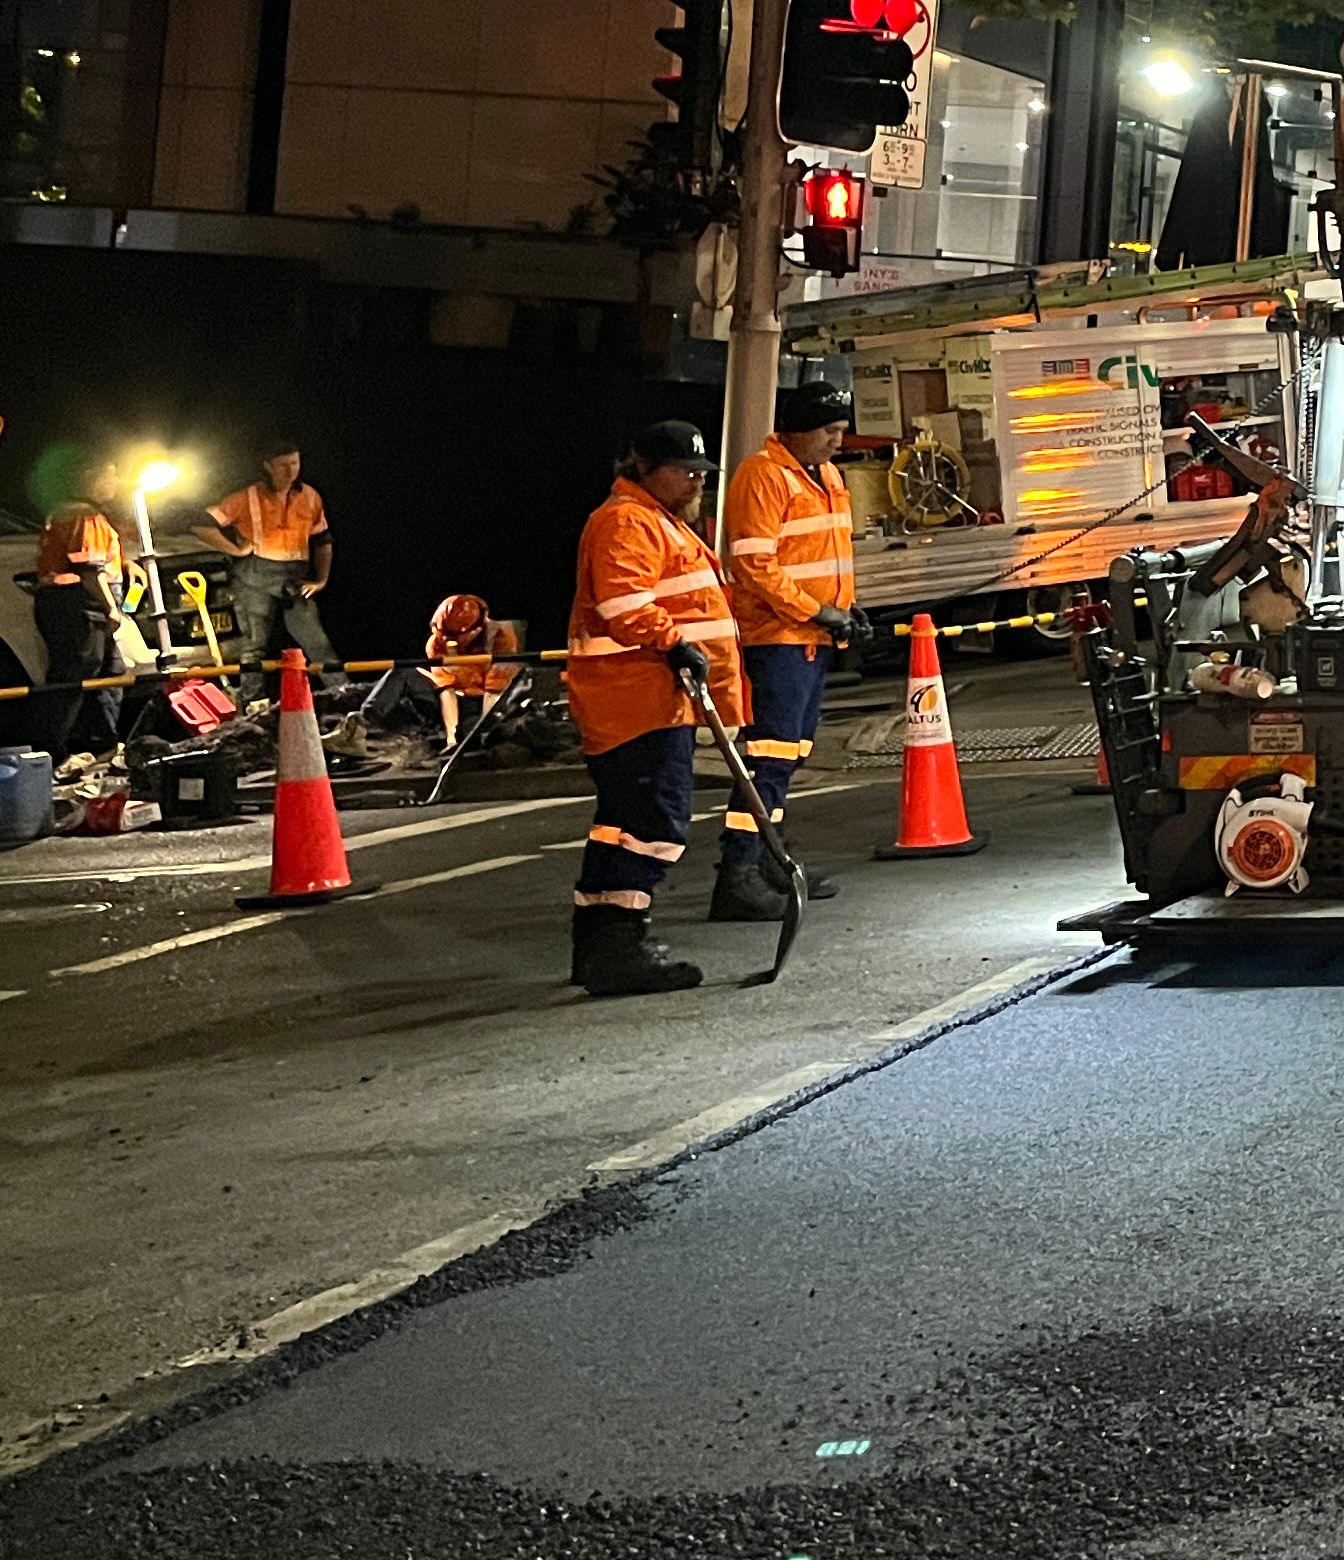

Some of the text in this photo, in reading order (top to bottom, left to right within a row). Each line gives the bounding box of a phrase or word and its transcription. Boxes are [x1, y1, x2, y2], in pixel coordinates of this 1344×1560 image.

[1110, 417, 1158, 431] SIGNALS
[1069, 432, 1156, 448] CONSTRUCTION
[907, 714, 942, 724] ALTUS
[1247, 809, 1276, 818] STIHL
